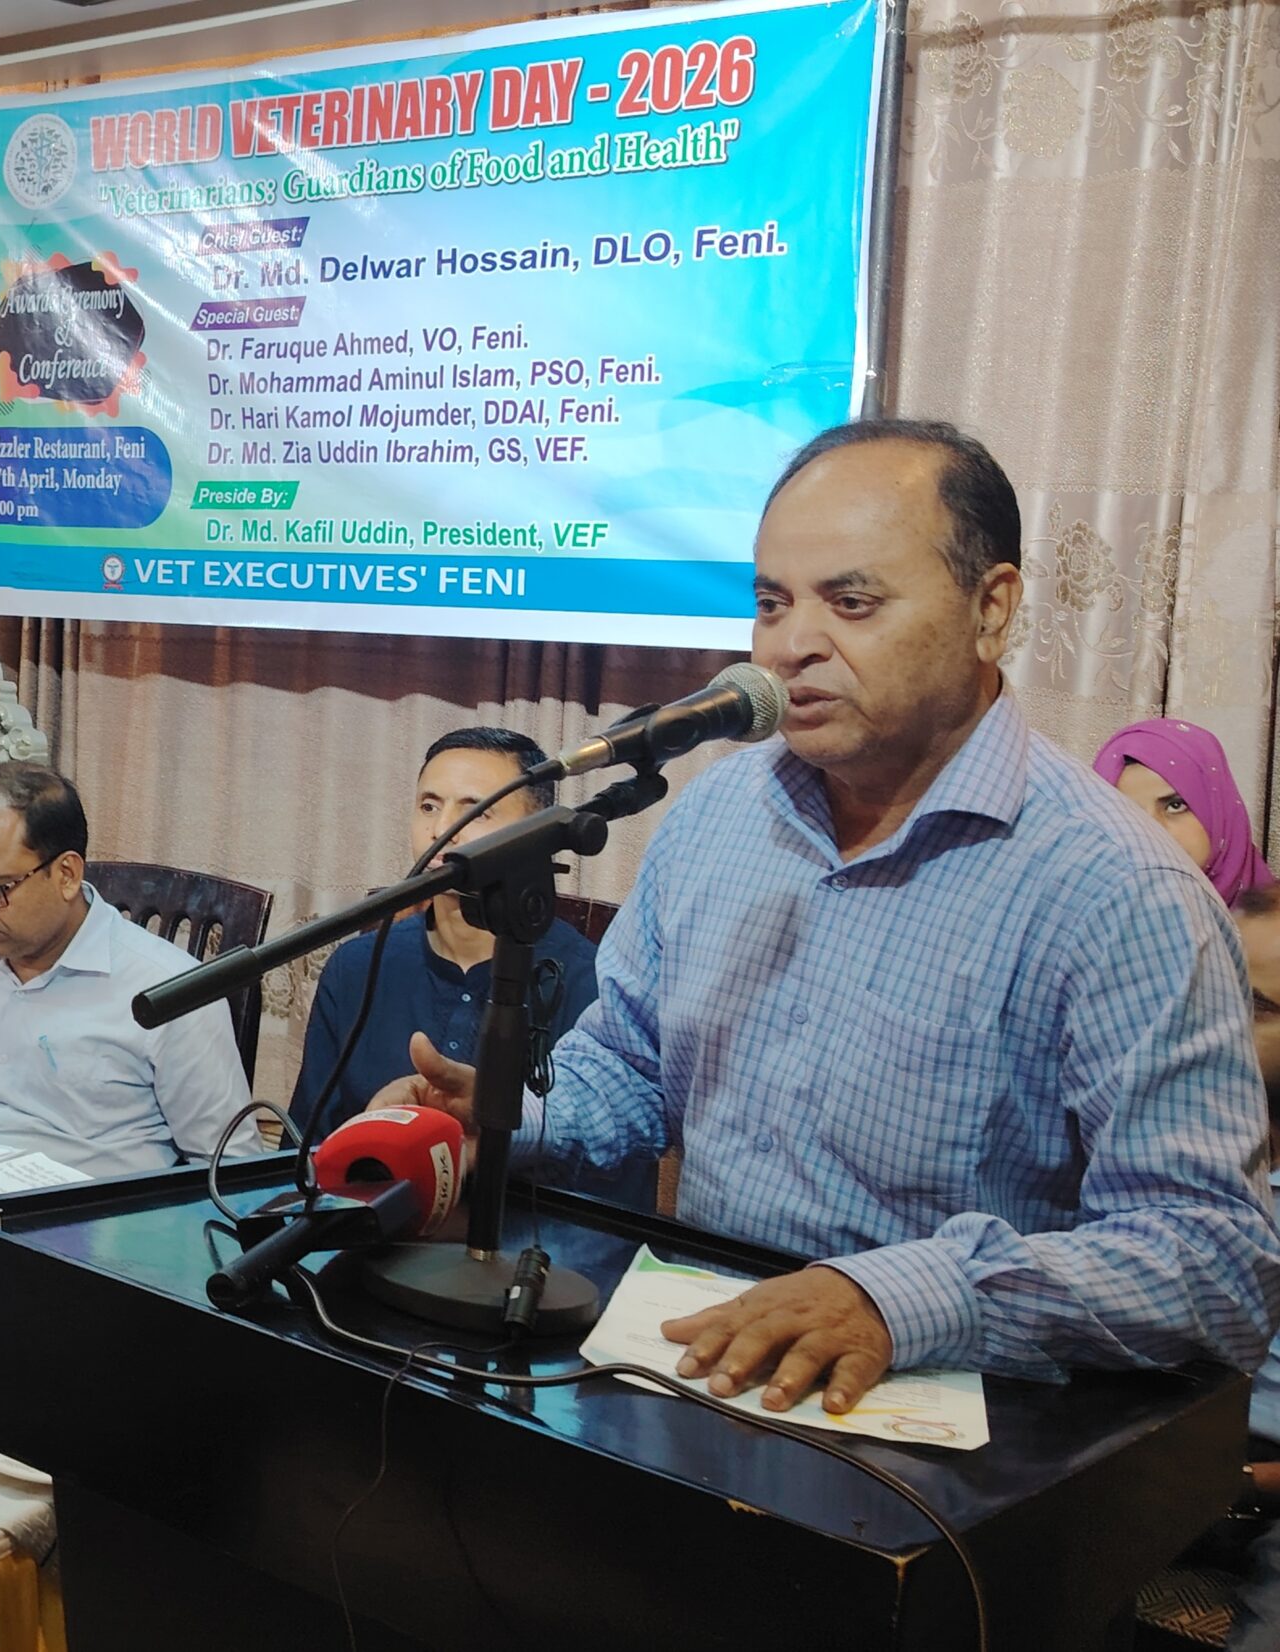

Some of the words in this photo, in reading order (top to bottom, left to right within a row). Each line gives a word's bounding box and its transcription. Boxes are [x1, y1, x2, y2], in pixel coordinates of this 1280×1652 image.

[90, 104, 222, 172] WORLD
[230, 69, 484, 158] VETERINARY
[489, 57, 584, 132] DAY
[616, 35, 756, 116] 2026
[282, 159, 424, 201] Guardians
[429, 153, 467, 190] of
[467, 142, 544, 186] Food
[548, 135, 606, 177] and
[614, 119, 740, 171] Health"
[202, 228, 244, 257] Chief
[247, 224, 302, 246] Guest:
[212, 265, 249, 290] Dr.
[260, 262, 309, 288] Md.
[319, 252, 426, 283] Delwar
[435, 244, 579, 276] Hossain,
[592, 232, 681, 266] DLO,
[695, 222, 786, 259] Feni.
[197, 306, 248, 327] Special
[253, 304, 299, 323] Guest:
[207, 336, 233, 362] Dr.
[240, 333, 328, 365] Faruque
[332, 330, 414, 358] Ahmed,
[422, 327, 462, 355] VO,
[470, 324, 529, 351] Feni.
[19, 349, 109, 389] Conference
[208, 371, 233, 396] Dr.
[239, 367, 362, 394] Mohammad
[368, 365, 444, 392] Aminul
[451, 363, 520, 390] Islam,
[530, 360, 590, 389] PSO,
[599, 356, 661, 384] Feni.
[210, 406, 235, 431] Dr.
[241, 405, 280, 430] Hari
[286, 404, 352, 430] Kamol
[359, 401, 476, 432] Mojumder,
[483, 400, 550, 427] DDAI,
[559, 398, 619, 423] Feni.
[34, 436, 111, 463] Restaurant,
[115, 437, 146, 459] Feni
[208, 442, 234, 465] Dr.
[241, 441, 276, 465] Md.
[282, 441, 313, 465] Zia
[318, 440, 378, 464] Uddin
[385, 439, 480, 467] Ibrahim,
[487, 438, 528, 466] GS,
[535, 436, 588, 463] VEF.
[18, 469, 60, 493] April,
[62, 470, 122, 495] Monday
[199, 488, 257, 504] Preside
[260, 488, 288, 505] By:
[17, 503, 39, 521] pm
[207, 518, 233, 543] Dr.
[241, 519, 278, 544] Md.
[284, 519, 335, 544] Kafil
[341, 520, 415, 549] Uddin,
[422, 520, 543, 552] President,
[552, 522, 608, 548] VEF
[134, 558, 195, 585] VET
[204, 560, 428, 593] EXECUTIVES'
[438, 566, 526, 596] FENI
